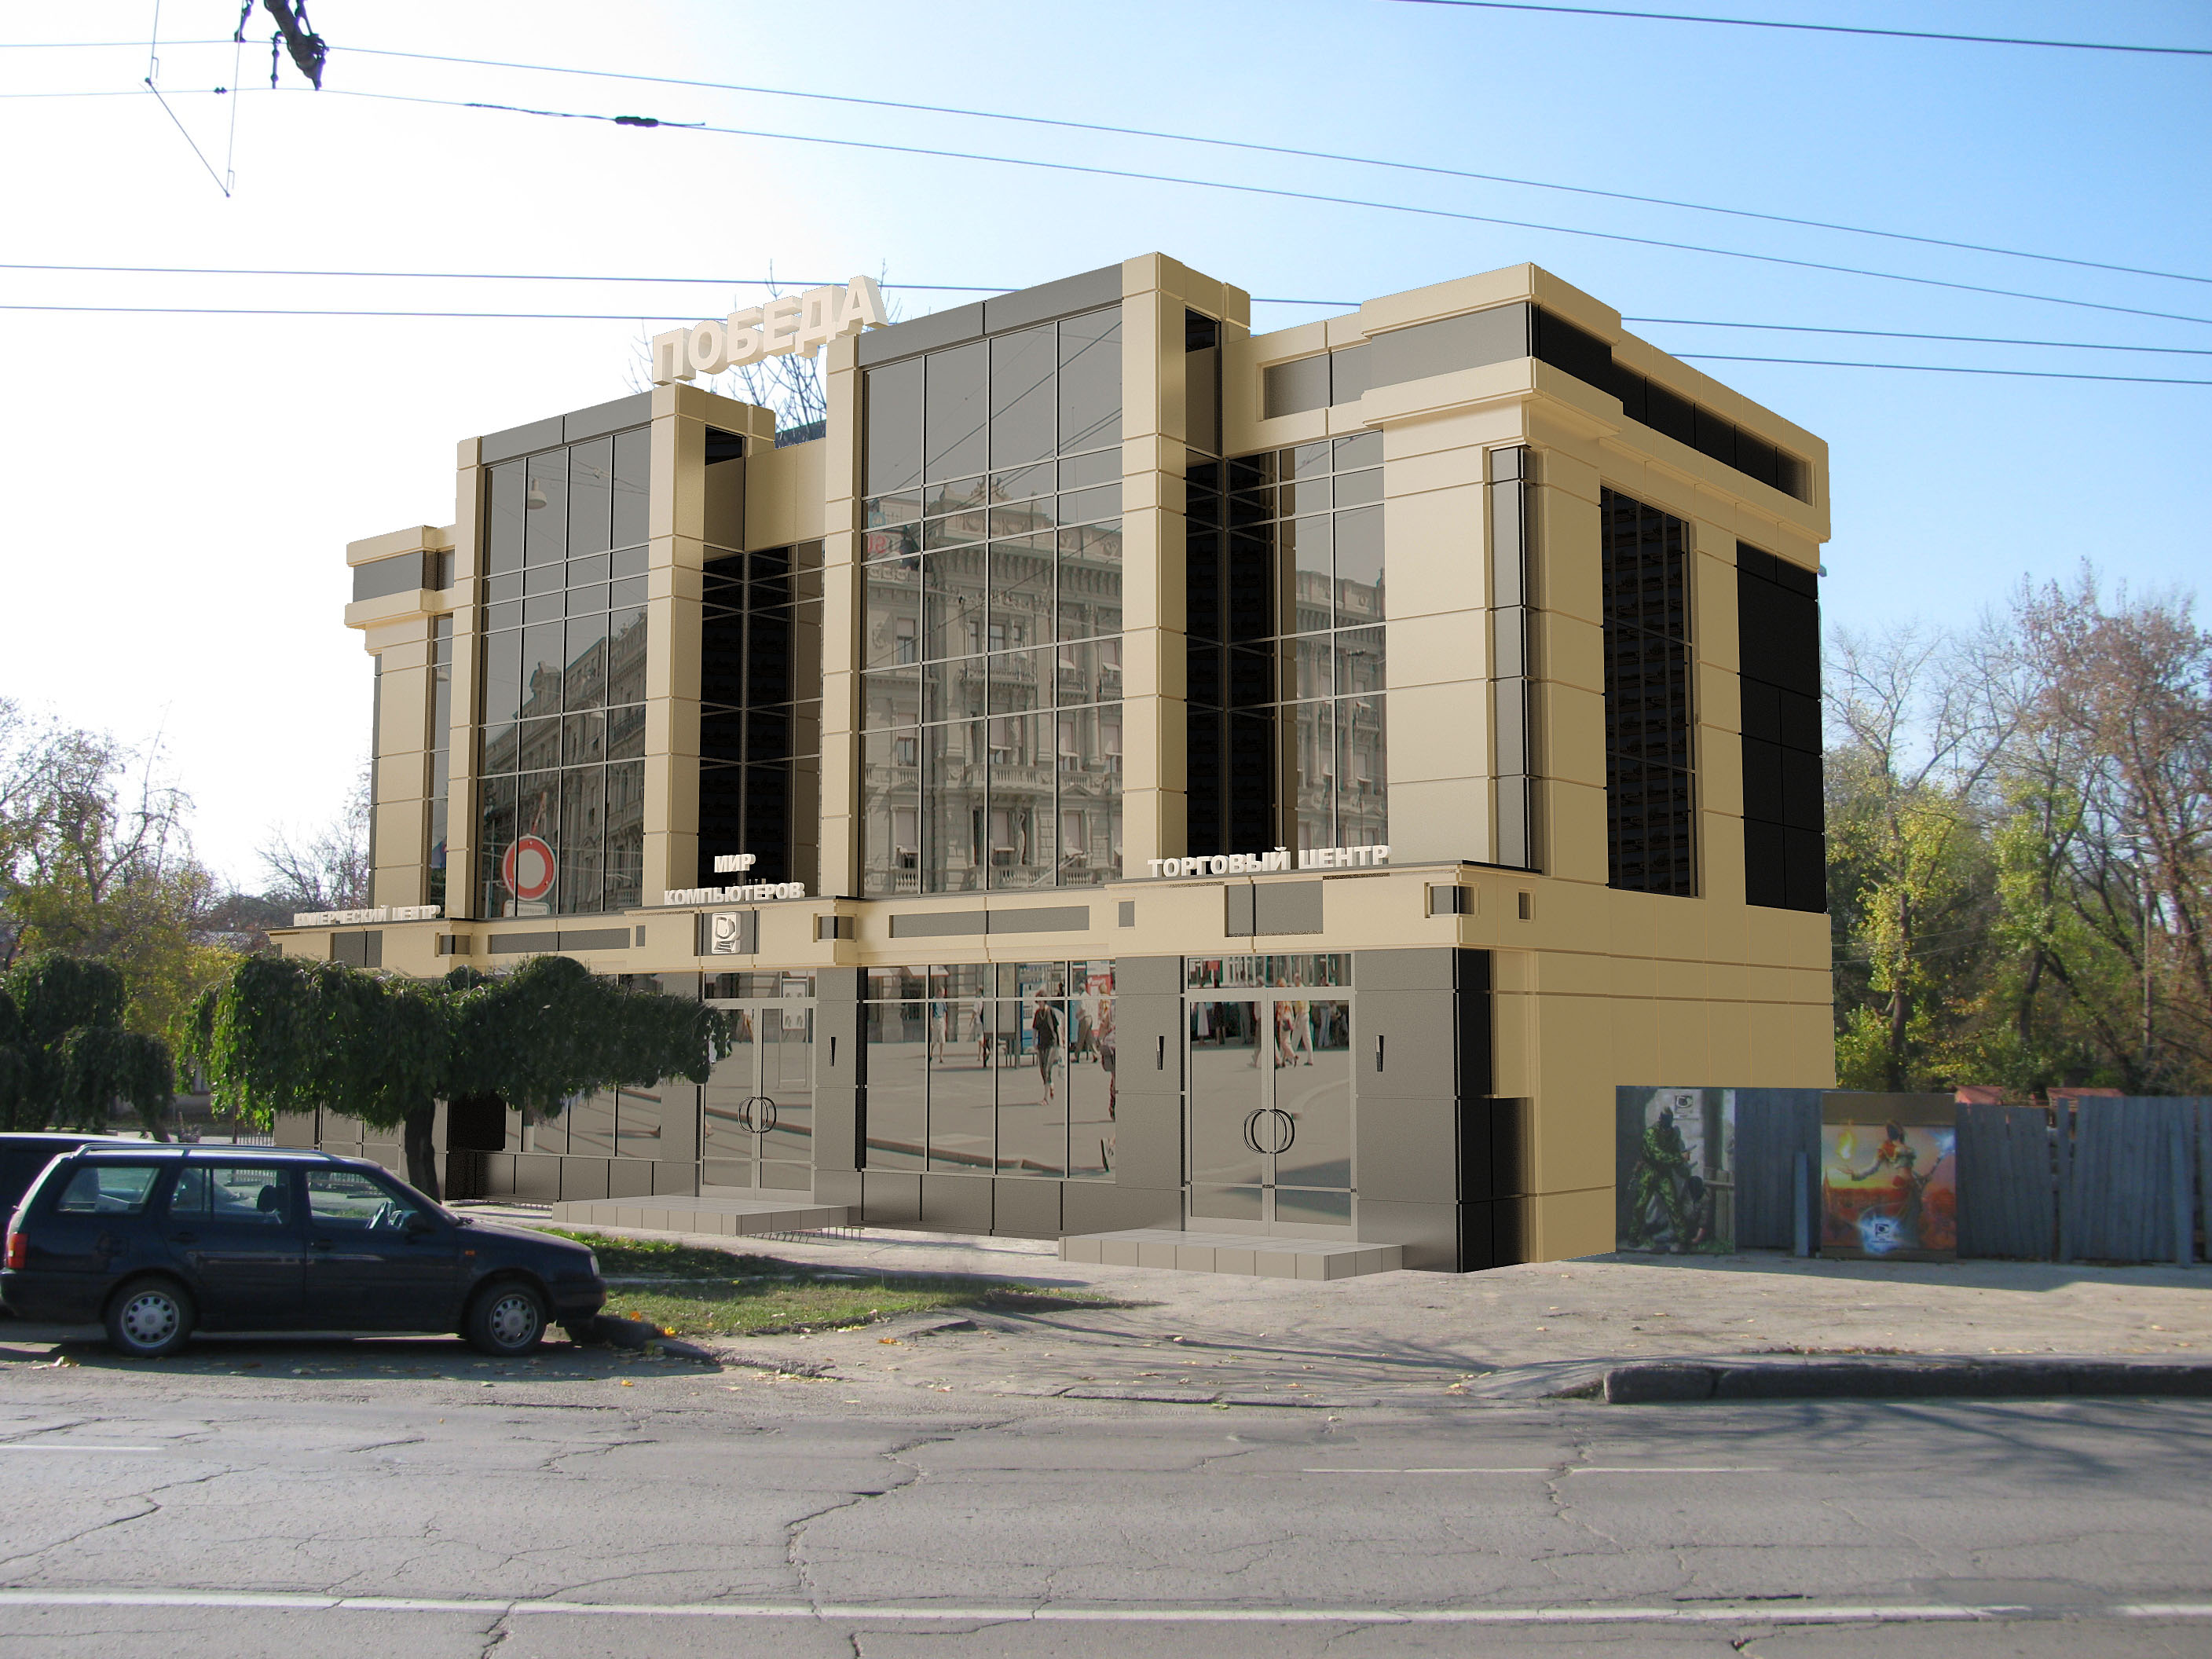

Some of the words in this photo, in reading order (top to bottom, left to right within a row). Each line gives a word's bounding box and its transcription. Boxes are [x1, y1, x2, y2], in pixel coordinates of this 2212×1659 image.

[652, 275, 888, 386] ПОБЕДА
[714, 853, 756, 873] МИР
[1148, 846, 1291, 877] ТОРГОВЫЙ
[1298, 844, 1390, 870] ЦЕНТР
[664, 881, 806, 906] КОМПЬЮТЕРОВ
[392, 904, 441, 921] ЦЕНТР
